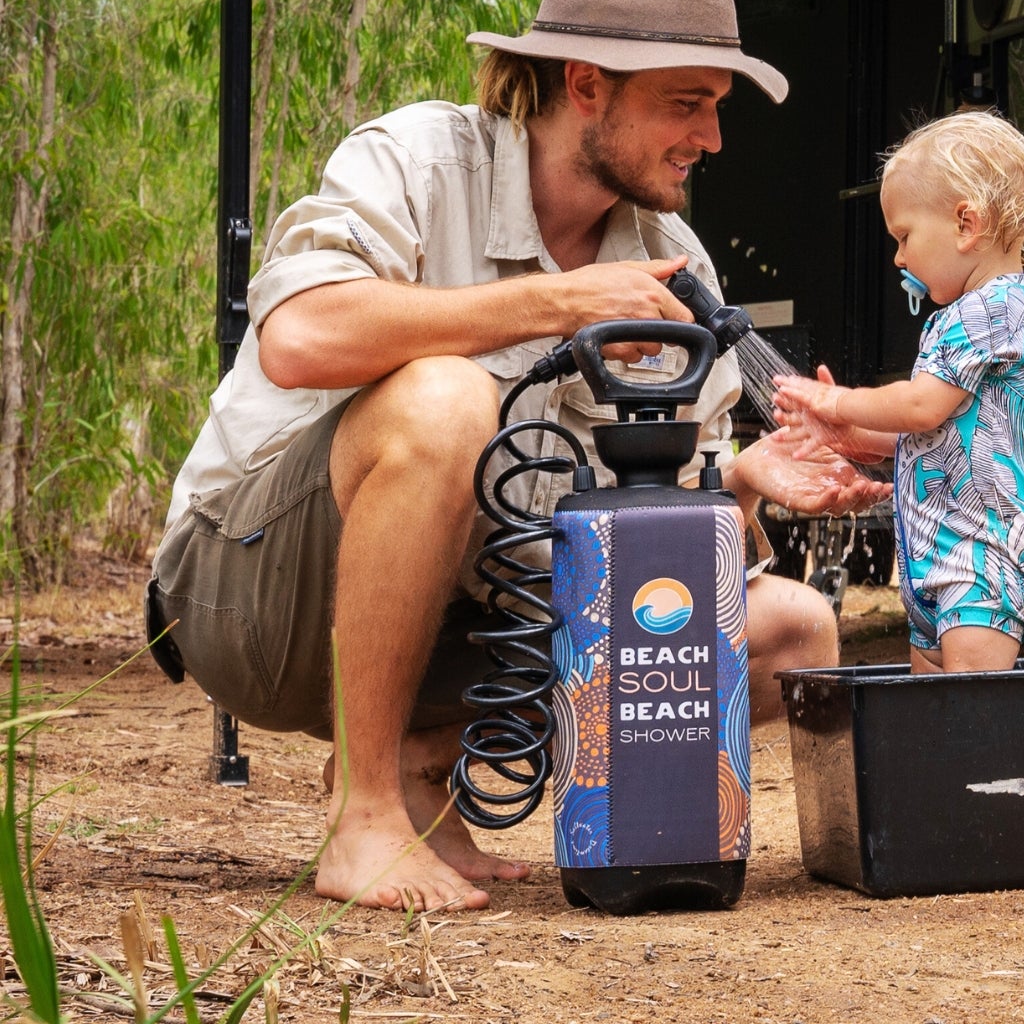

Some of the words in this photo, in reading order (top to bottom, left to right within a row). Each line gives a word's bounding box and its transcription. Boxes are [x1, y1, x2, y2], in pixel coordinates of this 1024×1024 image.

[620, 645, 709, 666] BEACH
[618, 670, 711, 694] SOUL
[620, 700, 710, 721] BEACH
[620, 727, 711, 743] SHOWER
